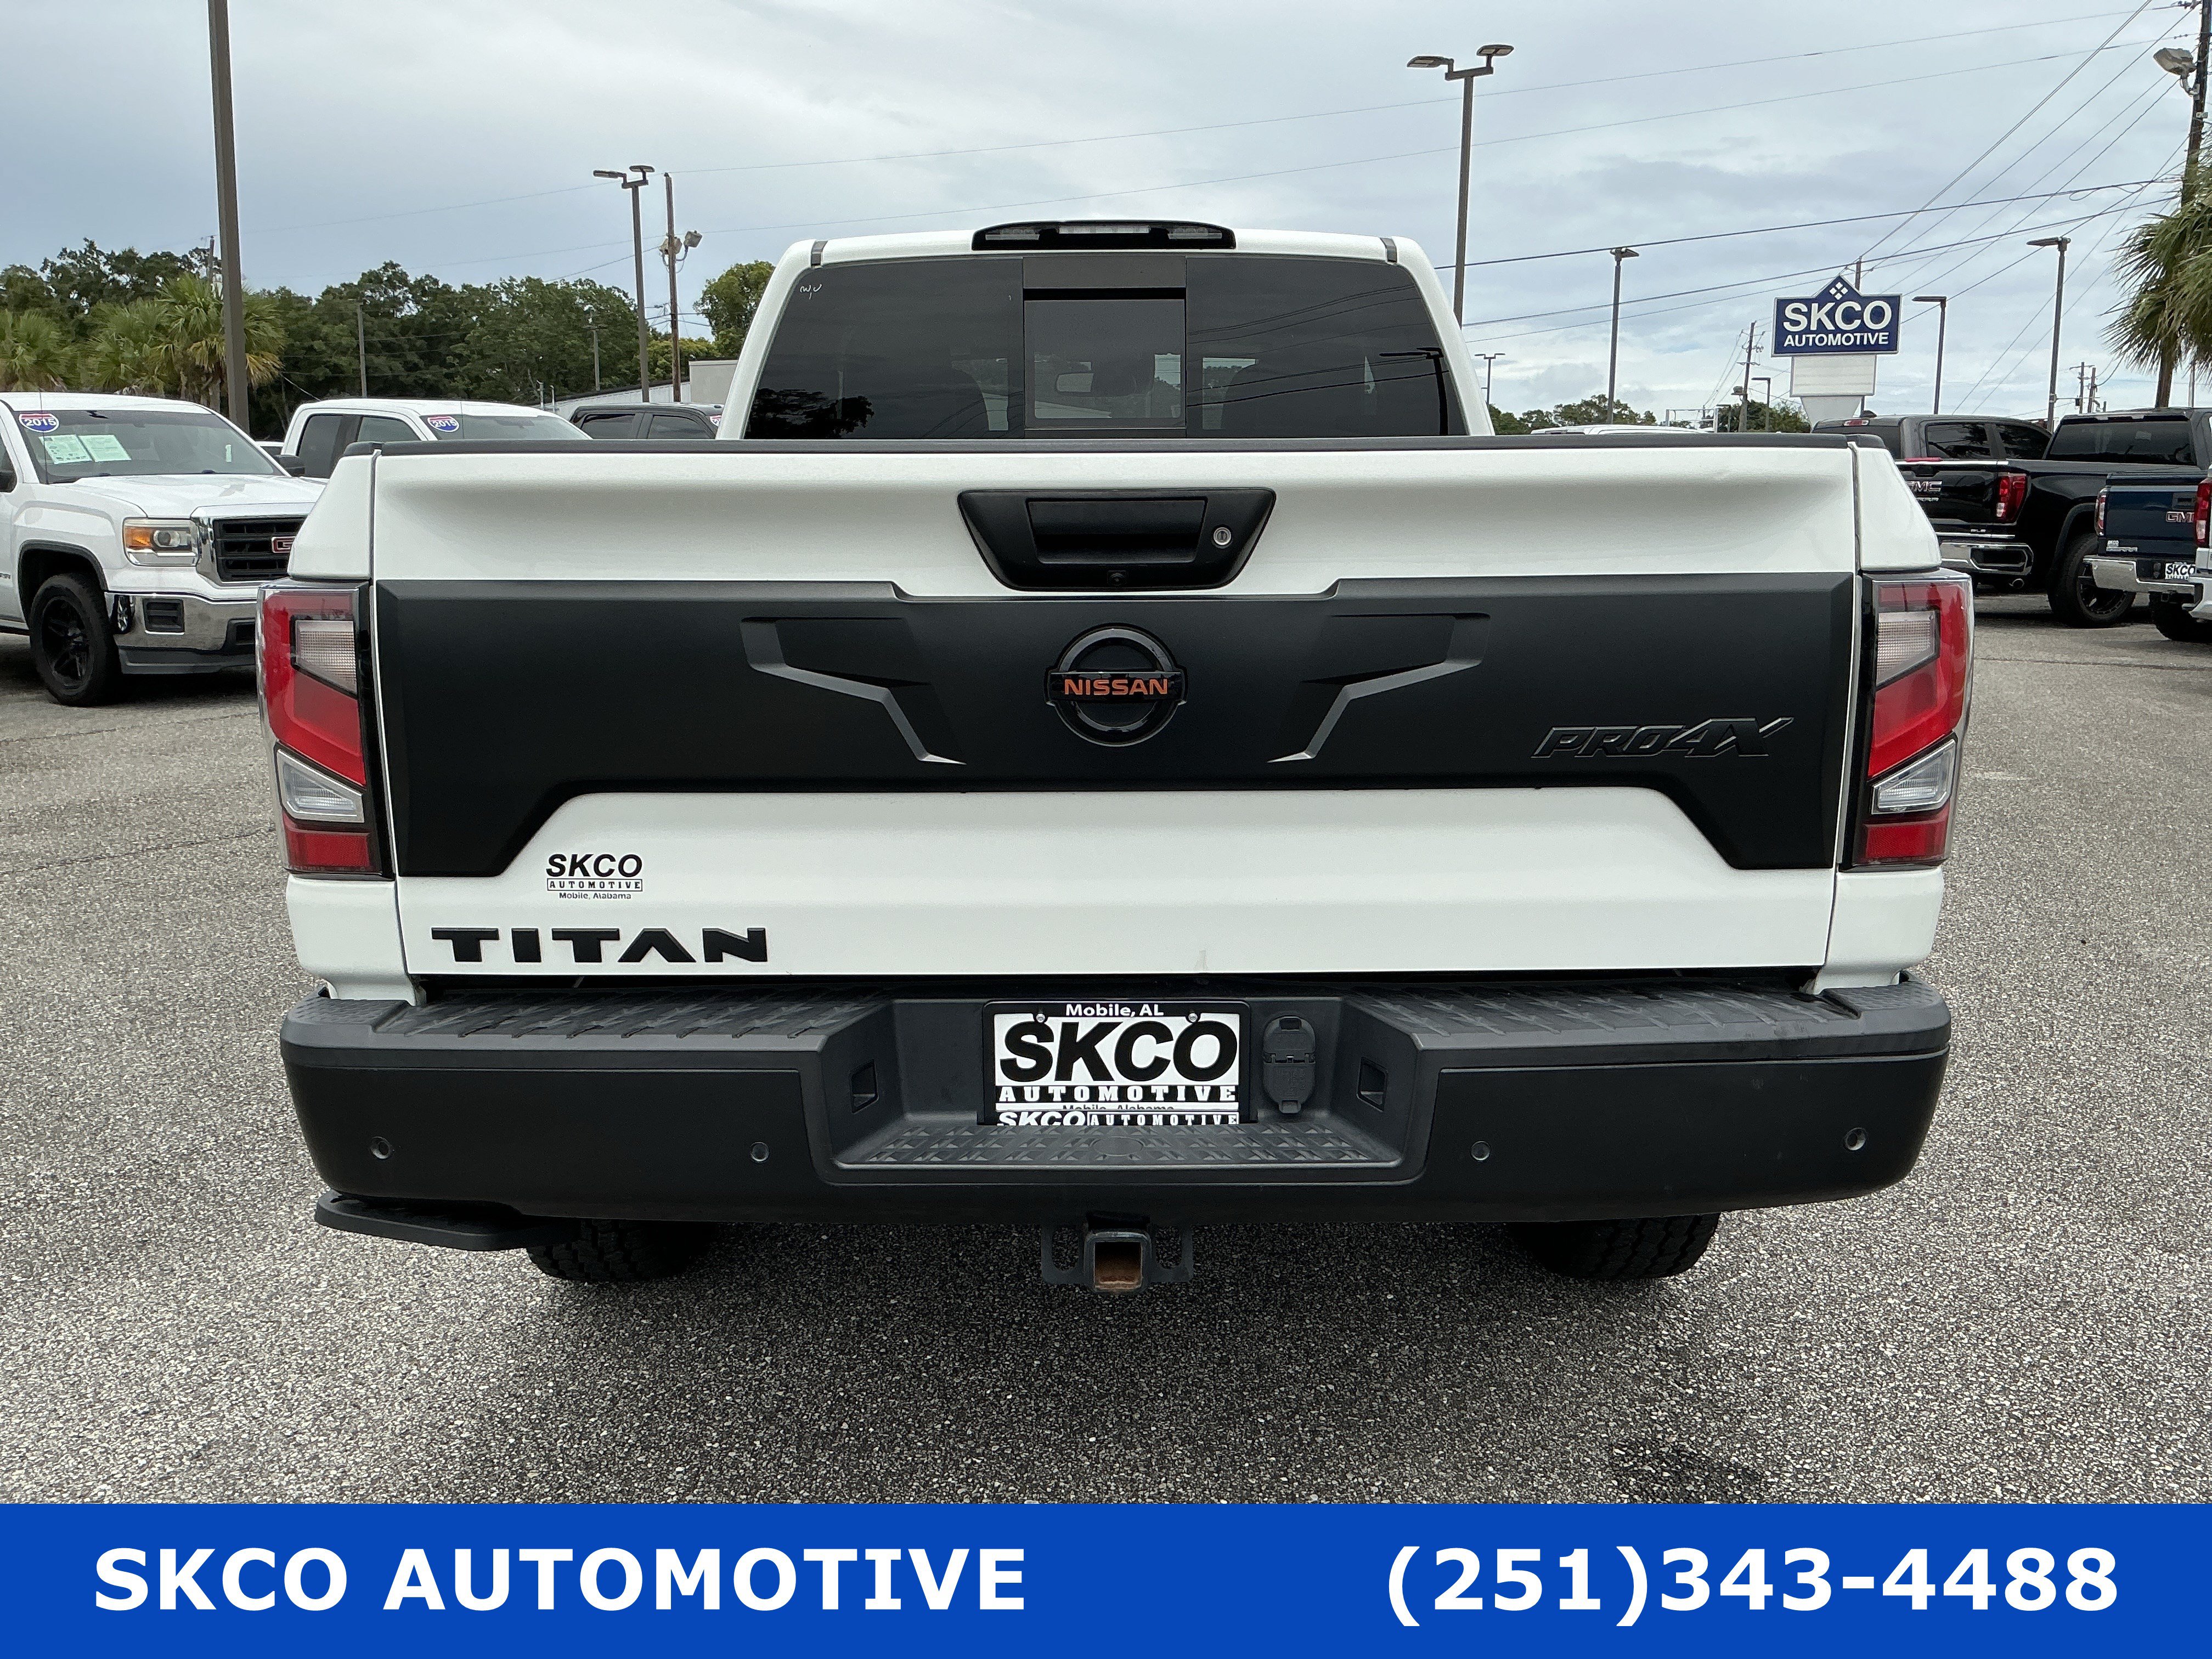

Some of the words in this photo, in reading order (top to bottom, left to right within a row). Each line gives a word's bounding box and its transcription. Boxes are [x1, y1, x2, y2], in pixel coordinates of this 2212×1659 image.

[1783, 301, 1892, 332] SKCO
[1784, 332, 1889, 347] AUTOMOTIVE
[24, 418, 57, 426] 2015
[2165, 511, 2195, 523] GM
[1064, 679, 1168, 695] NISSAN
[546, 854, 642, 878] SKCO
[550, 881, 640, 889] AUTOMOTIVE
[431, 928, 768, 963] TITAN
[1065, 1003, 1135, 1017] Mobile,
[1139, 1004, 1164, 1016] AL
[1000, 1020, 1238, 1082] SKCO
[999, 1086, 1236, 1102] AUTOMOTIVE
[997, 1111, 1086, 1126] SKCO
[1091, 1114, 1237, 1126] AUTOMOTIVE
